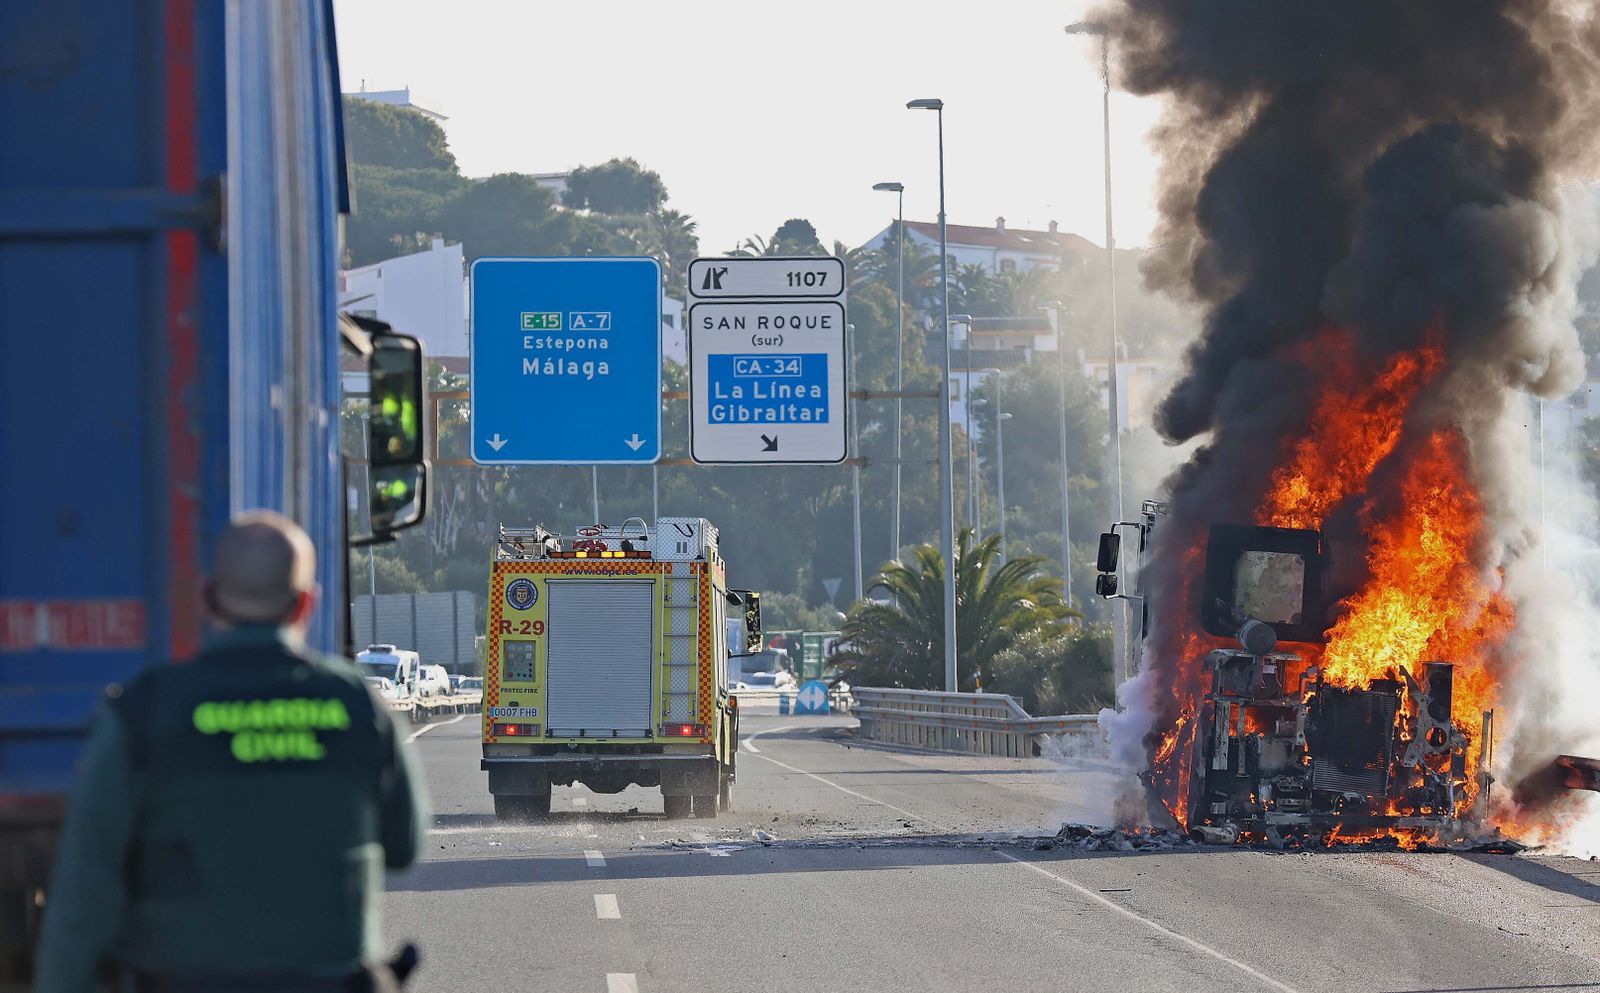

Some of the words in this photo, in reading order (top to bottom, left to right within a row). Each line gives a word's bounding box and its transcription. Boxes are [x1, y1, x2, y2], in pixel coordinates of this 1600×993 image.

[786, 271, 828, 287] 1107
[523, 314, 560, 329] E-15
[572, 314, 609, 329] A-7
[703, 316, 746, 330] SAN
[757, 315, 832, 330] ROQUE
[523, 335, 609, 352] Estepona
[751, 334, 784, 347] (sur)
[522, 357, 610, 380] Málaga
[735, 359, 800, 374] CA-34
[714, 382, 744, 399] La
[753, 381, 822, 399] Línea
[711, 403, 825, 422] Gibraltar
[498, 619, 545, 636] R-29
[193, 698, 350, 735] GUARDIA
[494, 708, 517, 717] 0007
[519, 708, 537, 717] FHB
[231, 729, 327, 763] CIVIL
